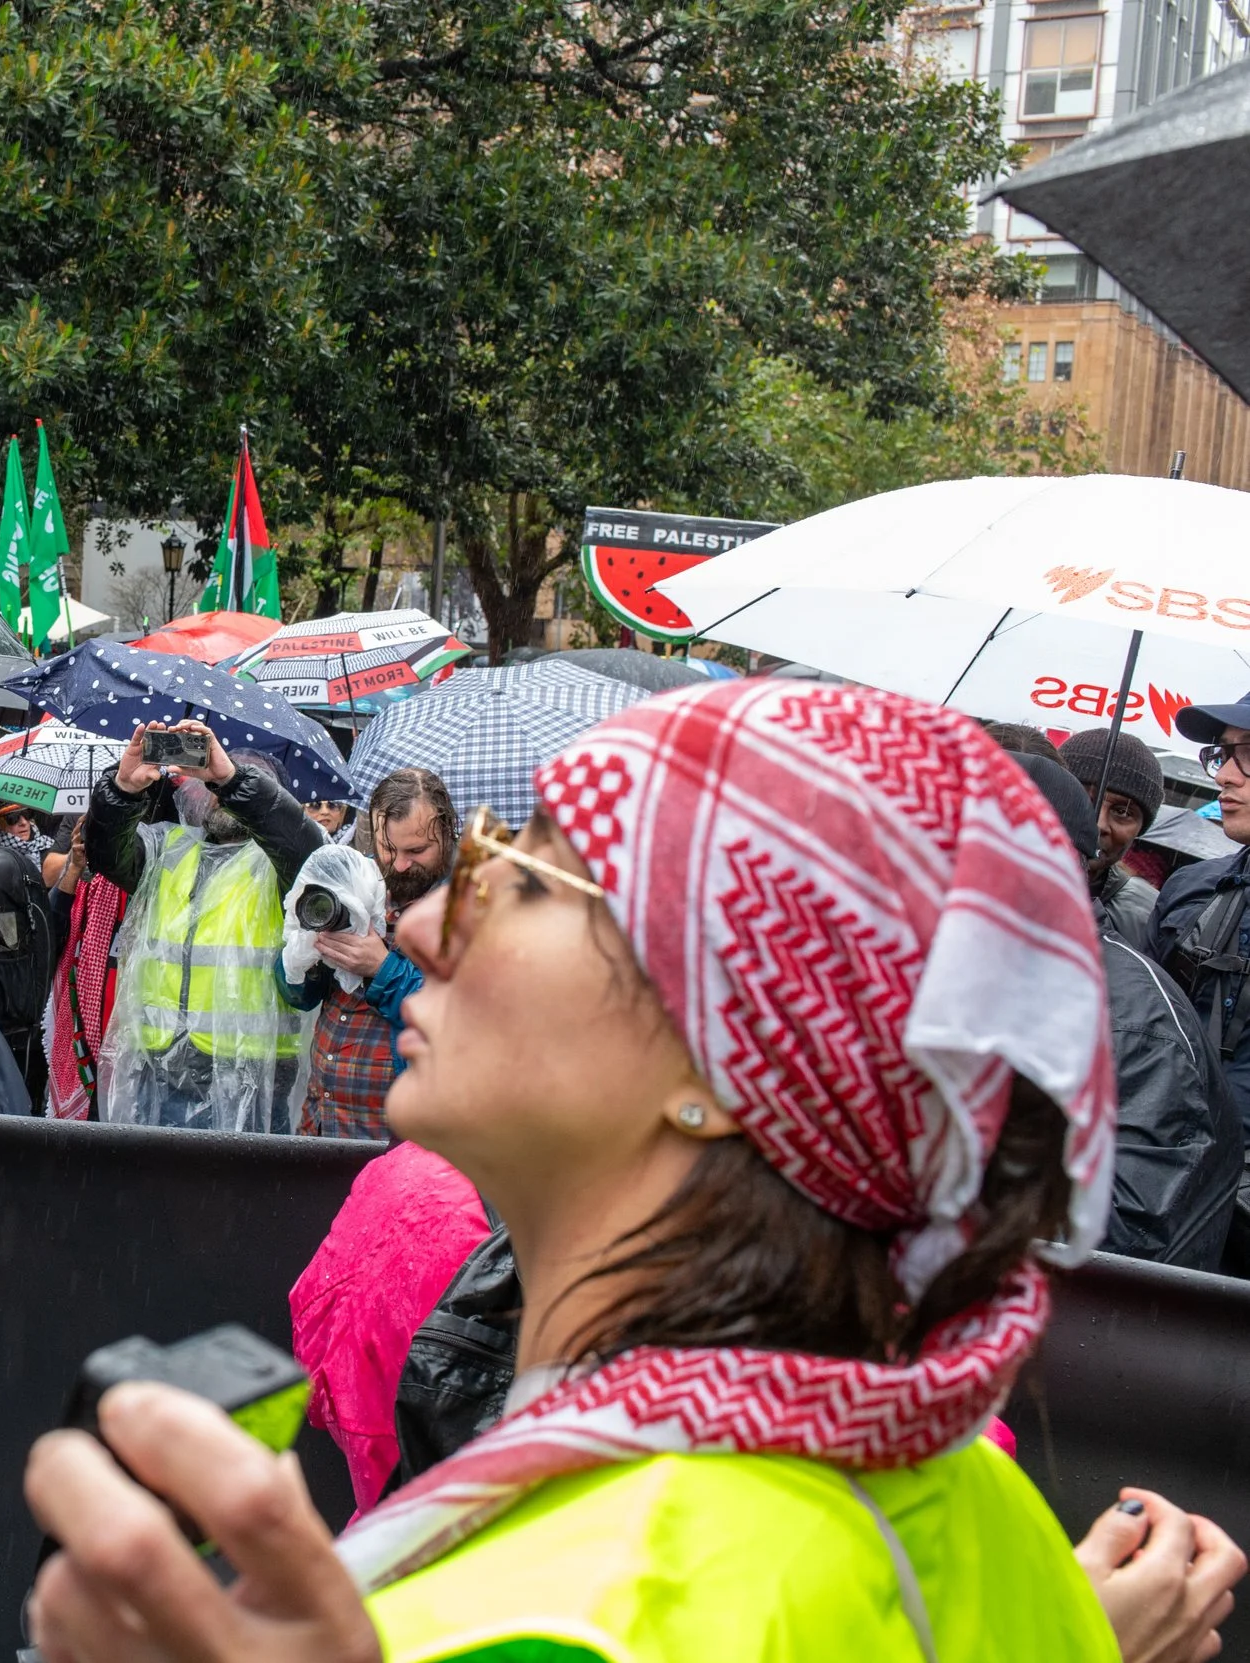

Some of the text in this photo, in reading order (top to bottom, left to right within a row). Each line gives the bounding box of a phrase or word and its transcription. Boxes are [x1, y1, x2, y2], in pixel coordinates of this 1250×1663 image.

[586, 522, 752, 551] FREE PALESTI
[1105, 580, 1250, 631] SBS
[272, 625, 429, 654] PALESTINE WILL BE
[54, 731, 91, 740] WILL
